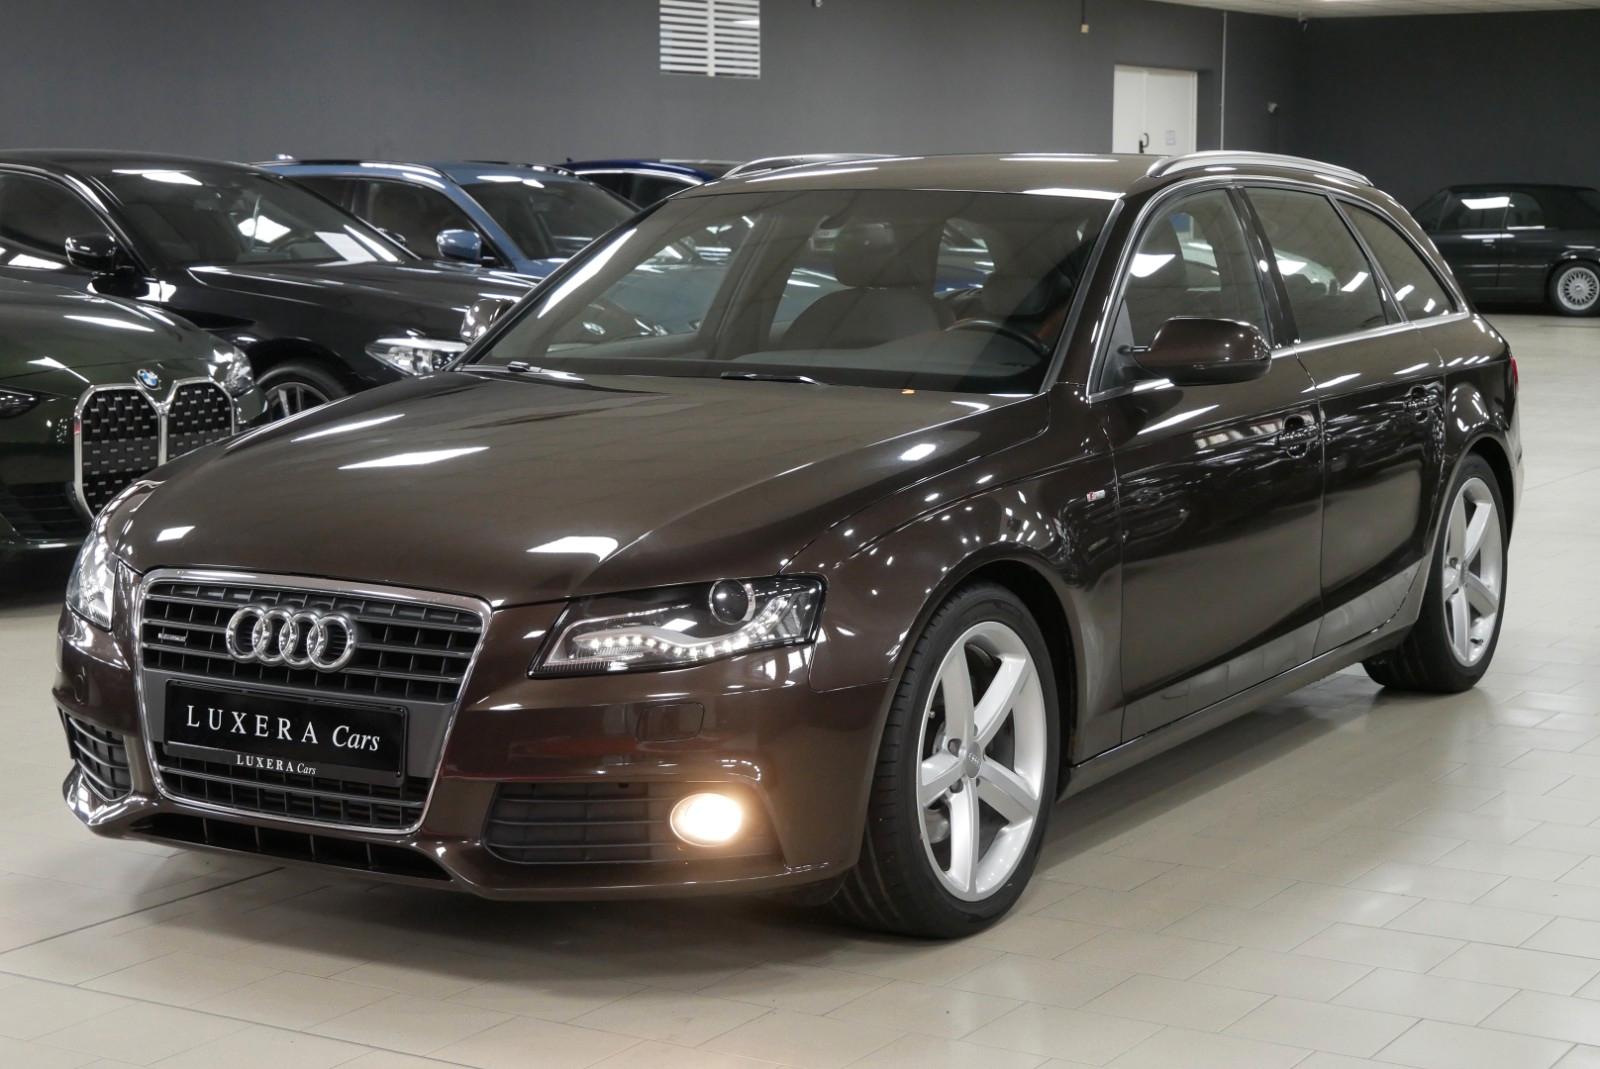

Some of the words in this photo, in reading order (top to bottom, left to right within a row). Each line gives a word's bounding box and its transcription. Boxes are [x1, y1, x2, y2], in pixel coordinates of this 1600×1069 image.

[186, 704, 319, 744] LUXERA
[332, 725, 380, 751] Cars
[236, 754, 294, 773] LUXERA
[296, 763, 317, 775] Cars
